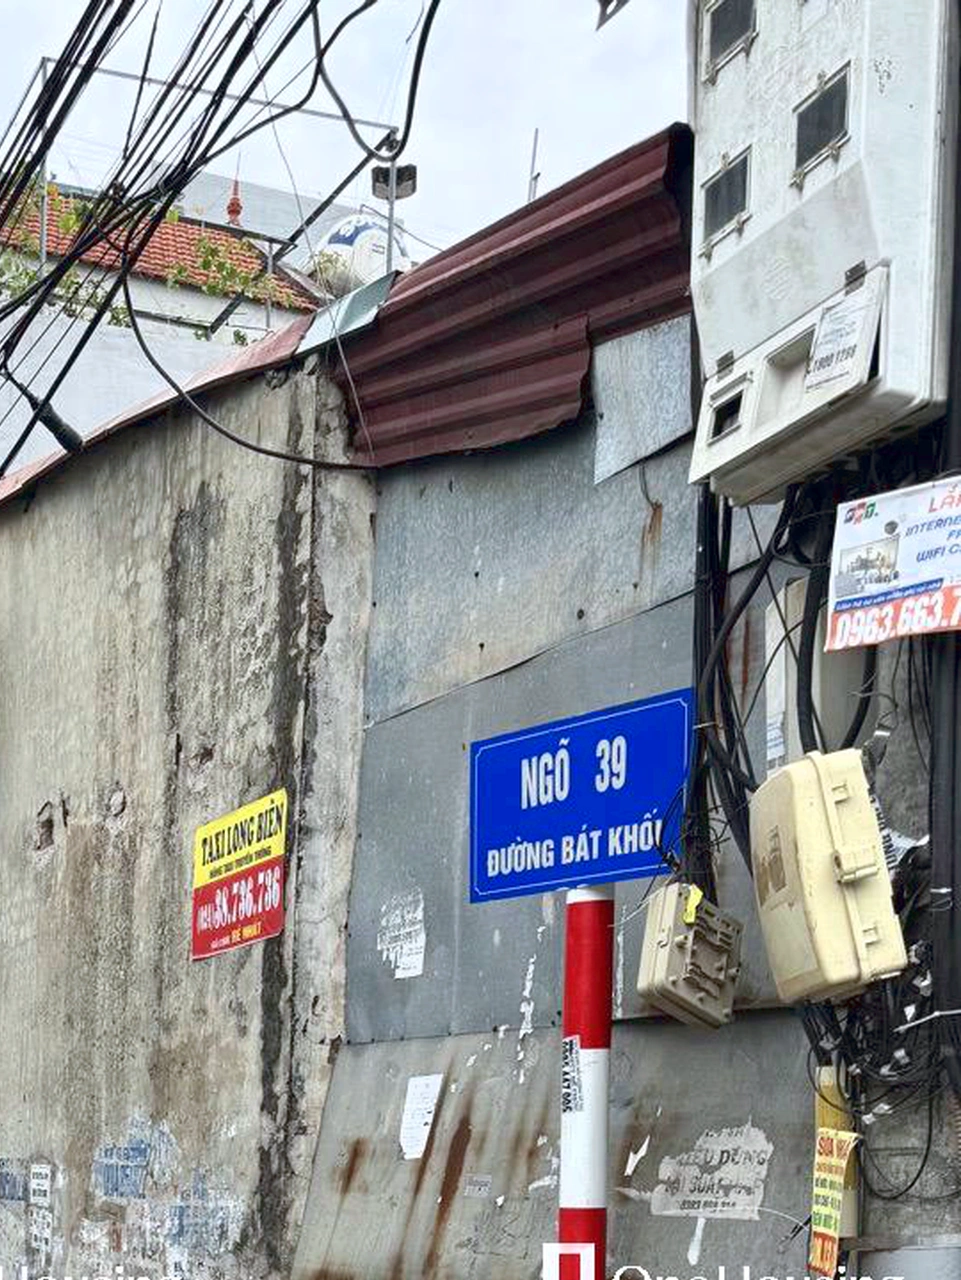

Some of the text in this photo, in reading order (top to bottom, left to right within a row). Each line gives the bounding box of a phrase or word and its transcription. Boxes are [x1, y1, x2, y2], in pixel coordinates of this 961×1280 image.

[520, 735, 628, 810] NGÕ 39
[487, 835, 555, 878] ĐƯỜNG
[561, 823, 603, 866] BÁT
